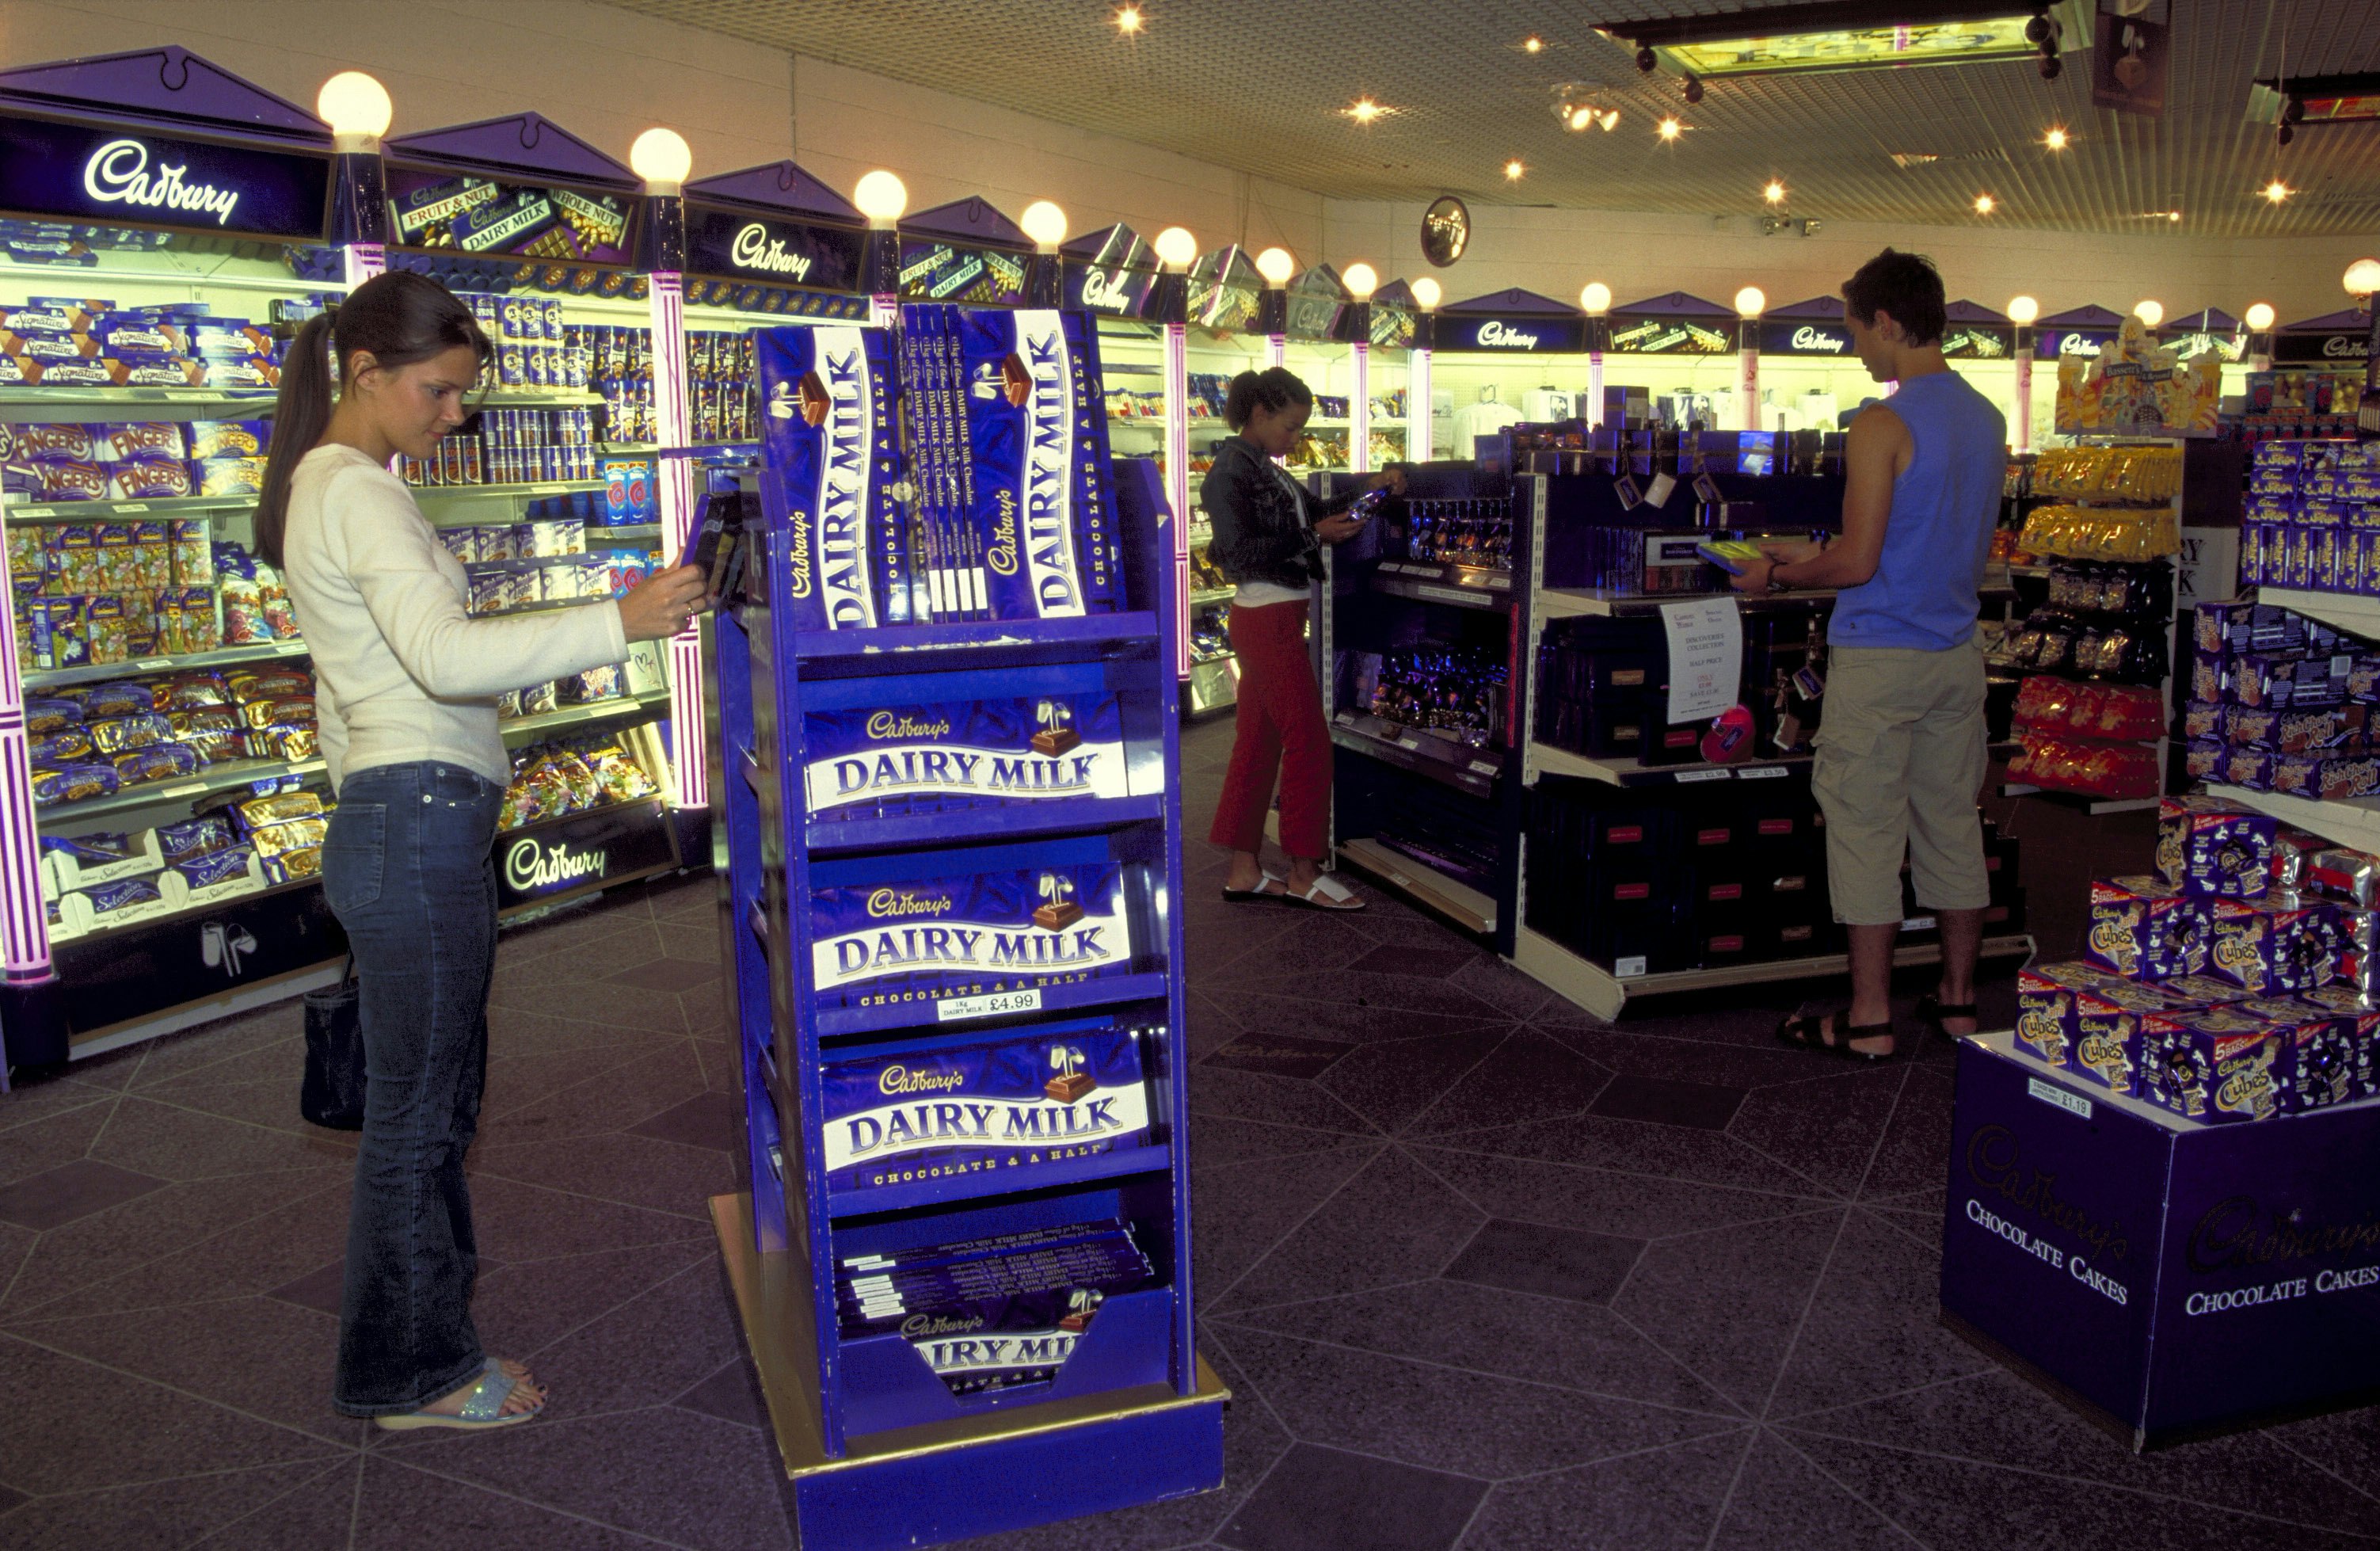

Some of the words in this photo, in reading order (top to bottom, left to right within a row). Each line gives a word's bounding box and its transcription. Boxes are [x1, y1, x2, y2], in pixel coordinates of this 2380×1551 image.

[84, 139, 238, 226] Cadbury
[408, 200, 451, 227] FRUIT
[452, 195, 464, 208] &
[464, 185, 492, 204] NUT
[592, 208, 618, 225] NUT
[469, 223, 511, 250] DAIRY
[512, 204, 546, 231] MILK
[731, 223, 811, 283] Cadbury
[901, 263, 927, 280] FRUIT
[934, 252, 951, 265] NUT
[933, 278, 958, 297] DAIRY
[958, 263, 980, 283] MILK
[1007, 263, 1021, 277] NUT
[1083, 271, 1131, 314] Cadbury
[14, 311, 67, 329] Signature
[27, 338, 74, 357] Signature
[112, 329, 161, 346] Signature
[1478, 322, 1537, 351] Cadbury
[1792, 326, 1844, 352] Cadbury
[53, 365, 105, 383] Signature
[135, 365, 183, 383] Signature
[912, 359, 920, 368] of
[925, 359, 934, 368] of
[939, 359, 947, 368] of
[953, 358, 962, 367] of
[1026, 330, 1067, 452] MILK
[1072, 354, 1087, 408] HALF
[824, 350, 860, 474] MILK
[874, 372, 886, 428] HALF
[914, 391, 923, 419] DAIRY
[927, 391, 937, 419] DAIRY
[942, 391, 951, 419] DAIRY
[957, 389, 966, 418] DAIRY
[917, 420, 926, 445] MILK
[931, 420, 940, 444] MILK
[944, 420, 954, 444] MILK
[959, 418, 969, 444] MILK
[1080, 417, 1090, 429] A
[16, 430, 86, 461] FINGERS
[110, 428, 182, 459] FINGERS
[878, 438, 888, 450] A
[919, 447, 928, 467] Milk
[933, 447, 942, 467] Milk
[962, 445, 972, 466] Milk
[1084, 440, 1093, 451] &
[881, 462, 890, 473] &
[117, 467, 185, 498] FINGERS
[920, 468, 930, 508] Chocolate
[935, 467, 944, 508] Chocolate
[964, 466, 973, 506] Chocolate
[988, 489, 1019, 575] Cadbury's
[1029, 456, 1071, 612] DAIRY
[1083, 462, 1105, 585] CHOCOLATE
[791, 511, 813, 598] Cadbury's
[821, 477, 865, 629] DAIRY
[1685, 633, 1725, 644] DISCOVERIES
[1686, 641, 1725, 652] COLLECTION
[1706, 657, 1723, 665] PRICE
[866, 711, 950, 740] Cadbury's
[2305, 720, 2335, 749] Roll
[835, 750, 984, 795] DAIRY
[988, 753, 1101, 792] MILK
[2346, 768, 2376, 797] Roll
[101, 863, 132, 881] Selection
[196, 853, 239, 888] Selection
[506, 839, 607, 894] Cadbury
[96, 881, 143, 912] Selection
[207, 883, 235, 901] Selection
[867, 888, 951, 917] Cadbury's
[2091, 888, 2099, 904] 5
[2099, 894, 2113, 902] BAGS
[113, 905, 146, 924] Selection
[2213, 902, 2220, 919] 5
[2220, 909, 2234, 918] BAGS
[2092, 920, 2133, 950] Cubes
[835, 927, 982, 976] DAIRY
[991, 925, 1110, 967] MILK
[2214, 938, 2257, 966] Cubes
[861, 983, 982, 1006] CHOCOLATE
[994, 981, 1004, 991] &
[1016, 979, 1026, 989] A
[1038, 972, 1089, 987] HALF
[2018, 977, 2025, 993] 5
[2025, 983, 2040, 992] BAGS
[943, 1008, 964, 1016] DAIRY
[990, 994, 1034, 1012] £4.99
[2078, 1000, 2086, 1016] 5
[2085, 1005, 2100, 1015] BAGS
[2019, 1012, 2059, 1040] Cubes
[2080, 1036, 2123, 1065] Cubes
[2215, 1042, 2226, 1061] 5
[2225, 1042, 2245, 1058] BAGS
[878, 1065, 964, 1096] Cadbury's
[2218, 1069, 2270, 1108] Cubes
[2062, 1095, 2087, 1115] £1.19
[847, 1103, 994, 1157] DAIRY
[1004, 1096, 1123, 1141] MILK
[874, 1158, 996, 1186] CHOCOLATE
[1007, 1157, 1019, 1167] &
[1030, 1153, 1040, 1164] A
[1050, 1143, 1102, 1161] HALF
[1967, 1124, 2127, 1261] Cadbury's
[2187, 1195, 2380, 1274] Cadbury's
[1966, 1198, 2062, 1269] CHOCOLATE
[2069, 1256, 2127, 1306] CAKES
[2186, 1277, 2307, 1317] CHOCOLATE
[2315, 1265, 2380, 1294] CAKES
[901, 1313, 984, 1339] Cadbury's
